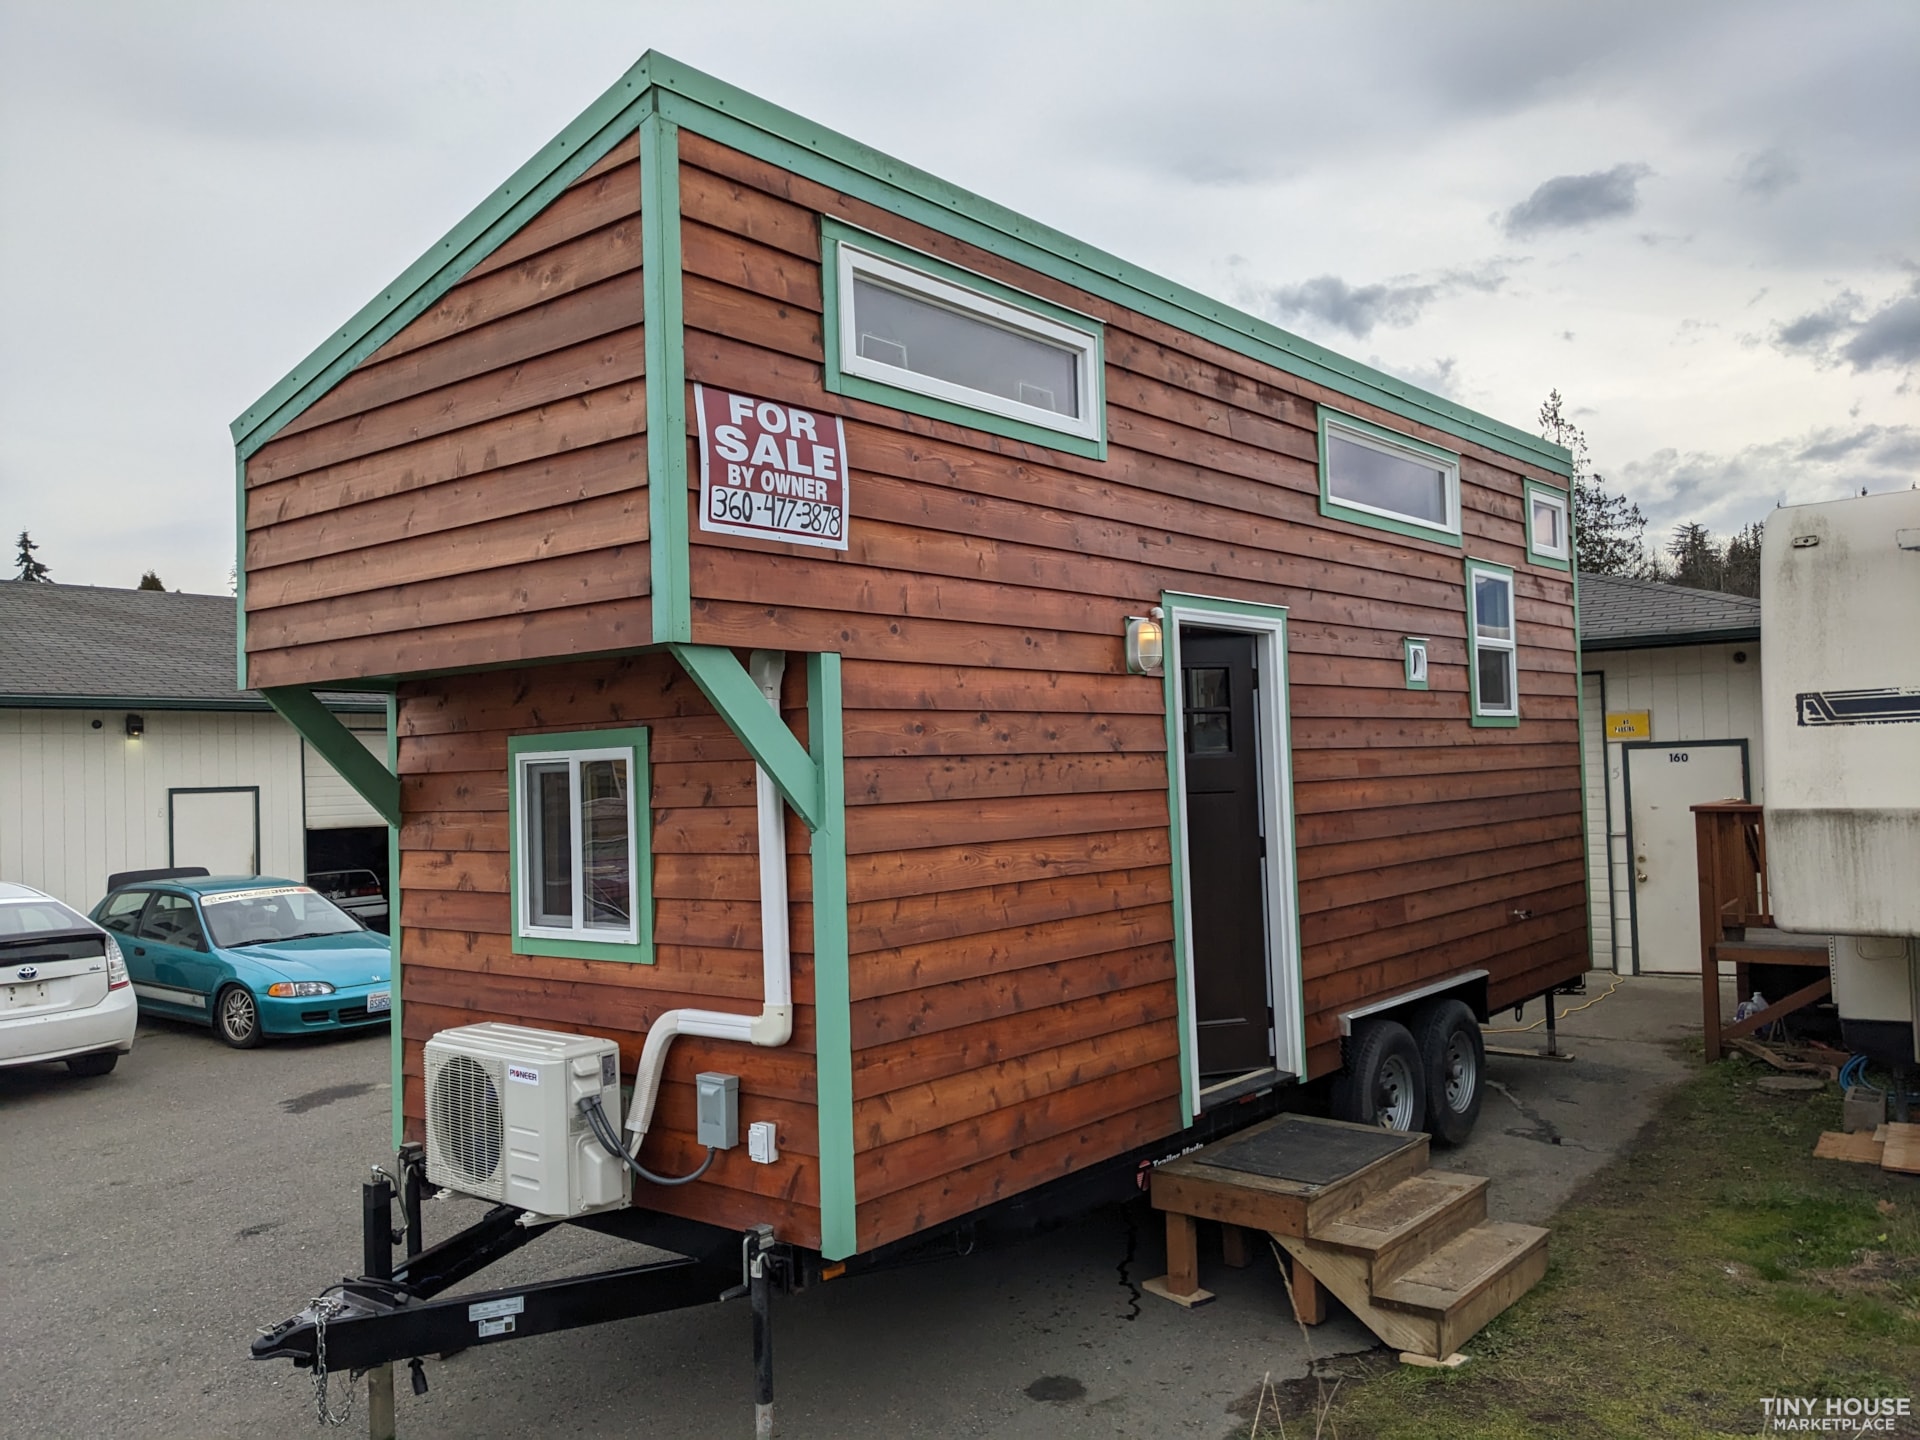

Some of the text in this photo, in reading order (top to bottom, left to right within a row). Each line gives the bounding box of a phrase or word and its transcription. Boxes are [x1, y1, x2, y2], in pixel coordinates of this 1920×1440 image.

[729, 393, 818, 442] FOR
[714, 425, 837, 480] SALE
[728, 463, 828, 501] BY OWNER
[1669, 753, 1688, 762] 160
[509, 1069, 537, 1081] PIONEER
